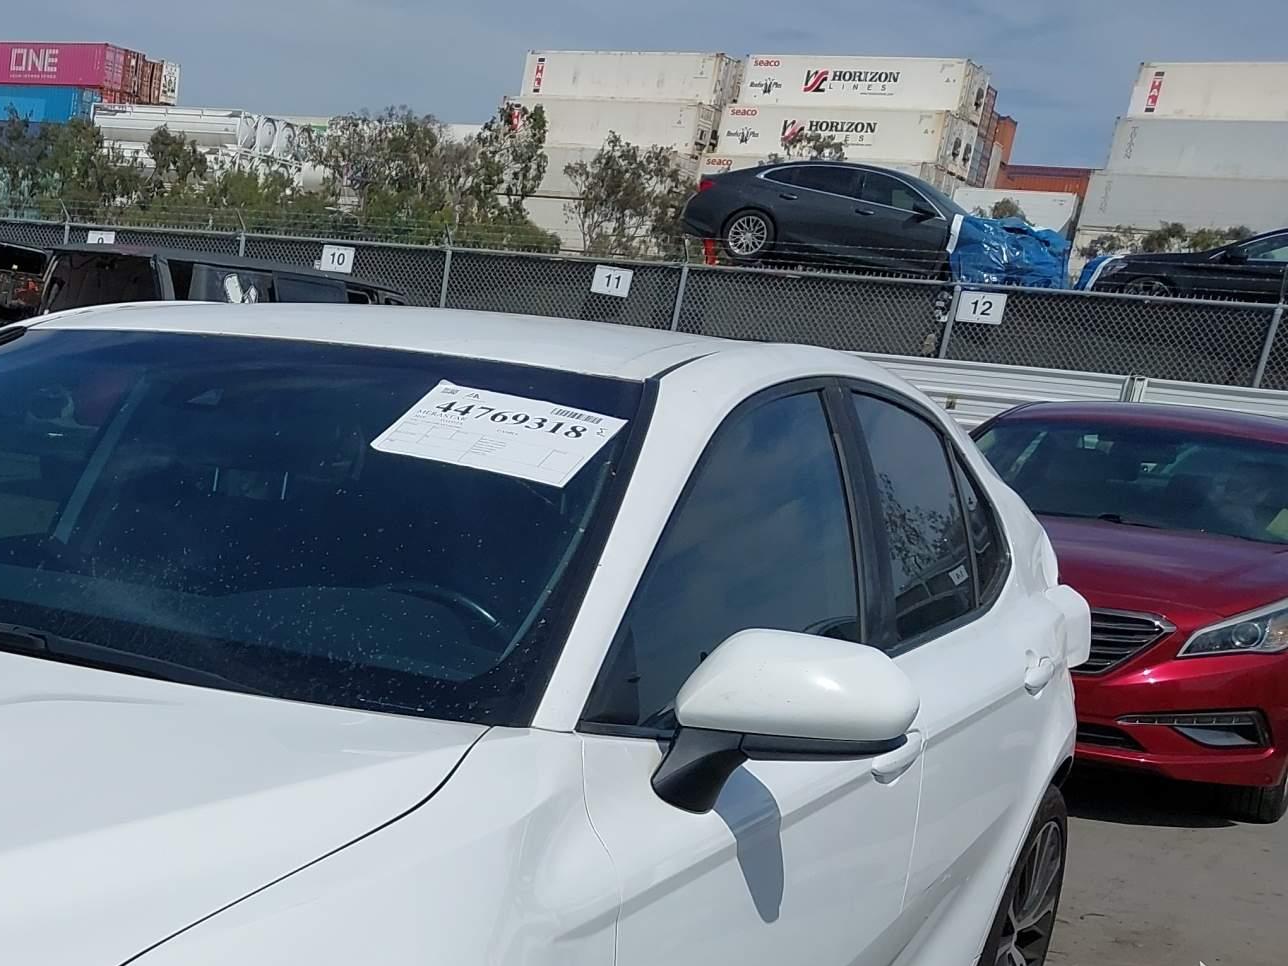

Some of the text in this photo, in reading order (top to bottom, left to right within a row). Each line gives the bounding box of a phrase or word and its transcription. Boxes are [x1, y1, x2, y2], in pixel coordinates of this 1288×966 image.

[10, 48, 59, 71] ONE
[753, 59, 780, 67] seaco
[831, 70, 901, 83] HORIZON
[828, 83, 887, 92] LINES
[1146, 79, 1163, 106] TAL
[730, 108, 757, 116] seaco
[808, 120, 878, 133] HORIZON
[330, 251, 346, 266] 10
[605, 273, 622, 289] 11
[971, 299, 993, 316] 12
[435, 401, 587, 439] 44769318
